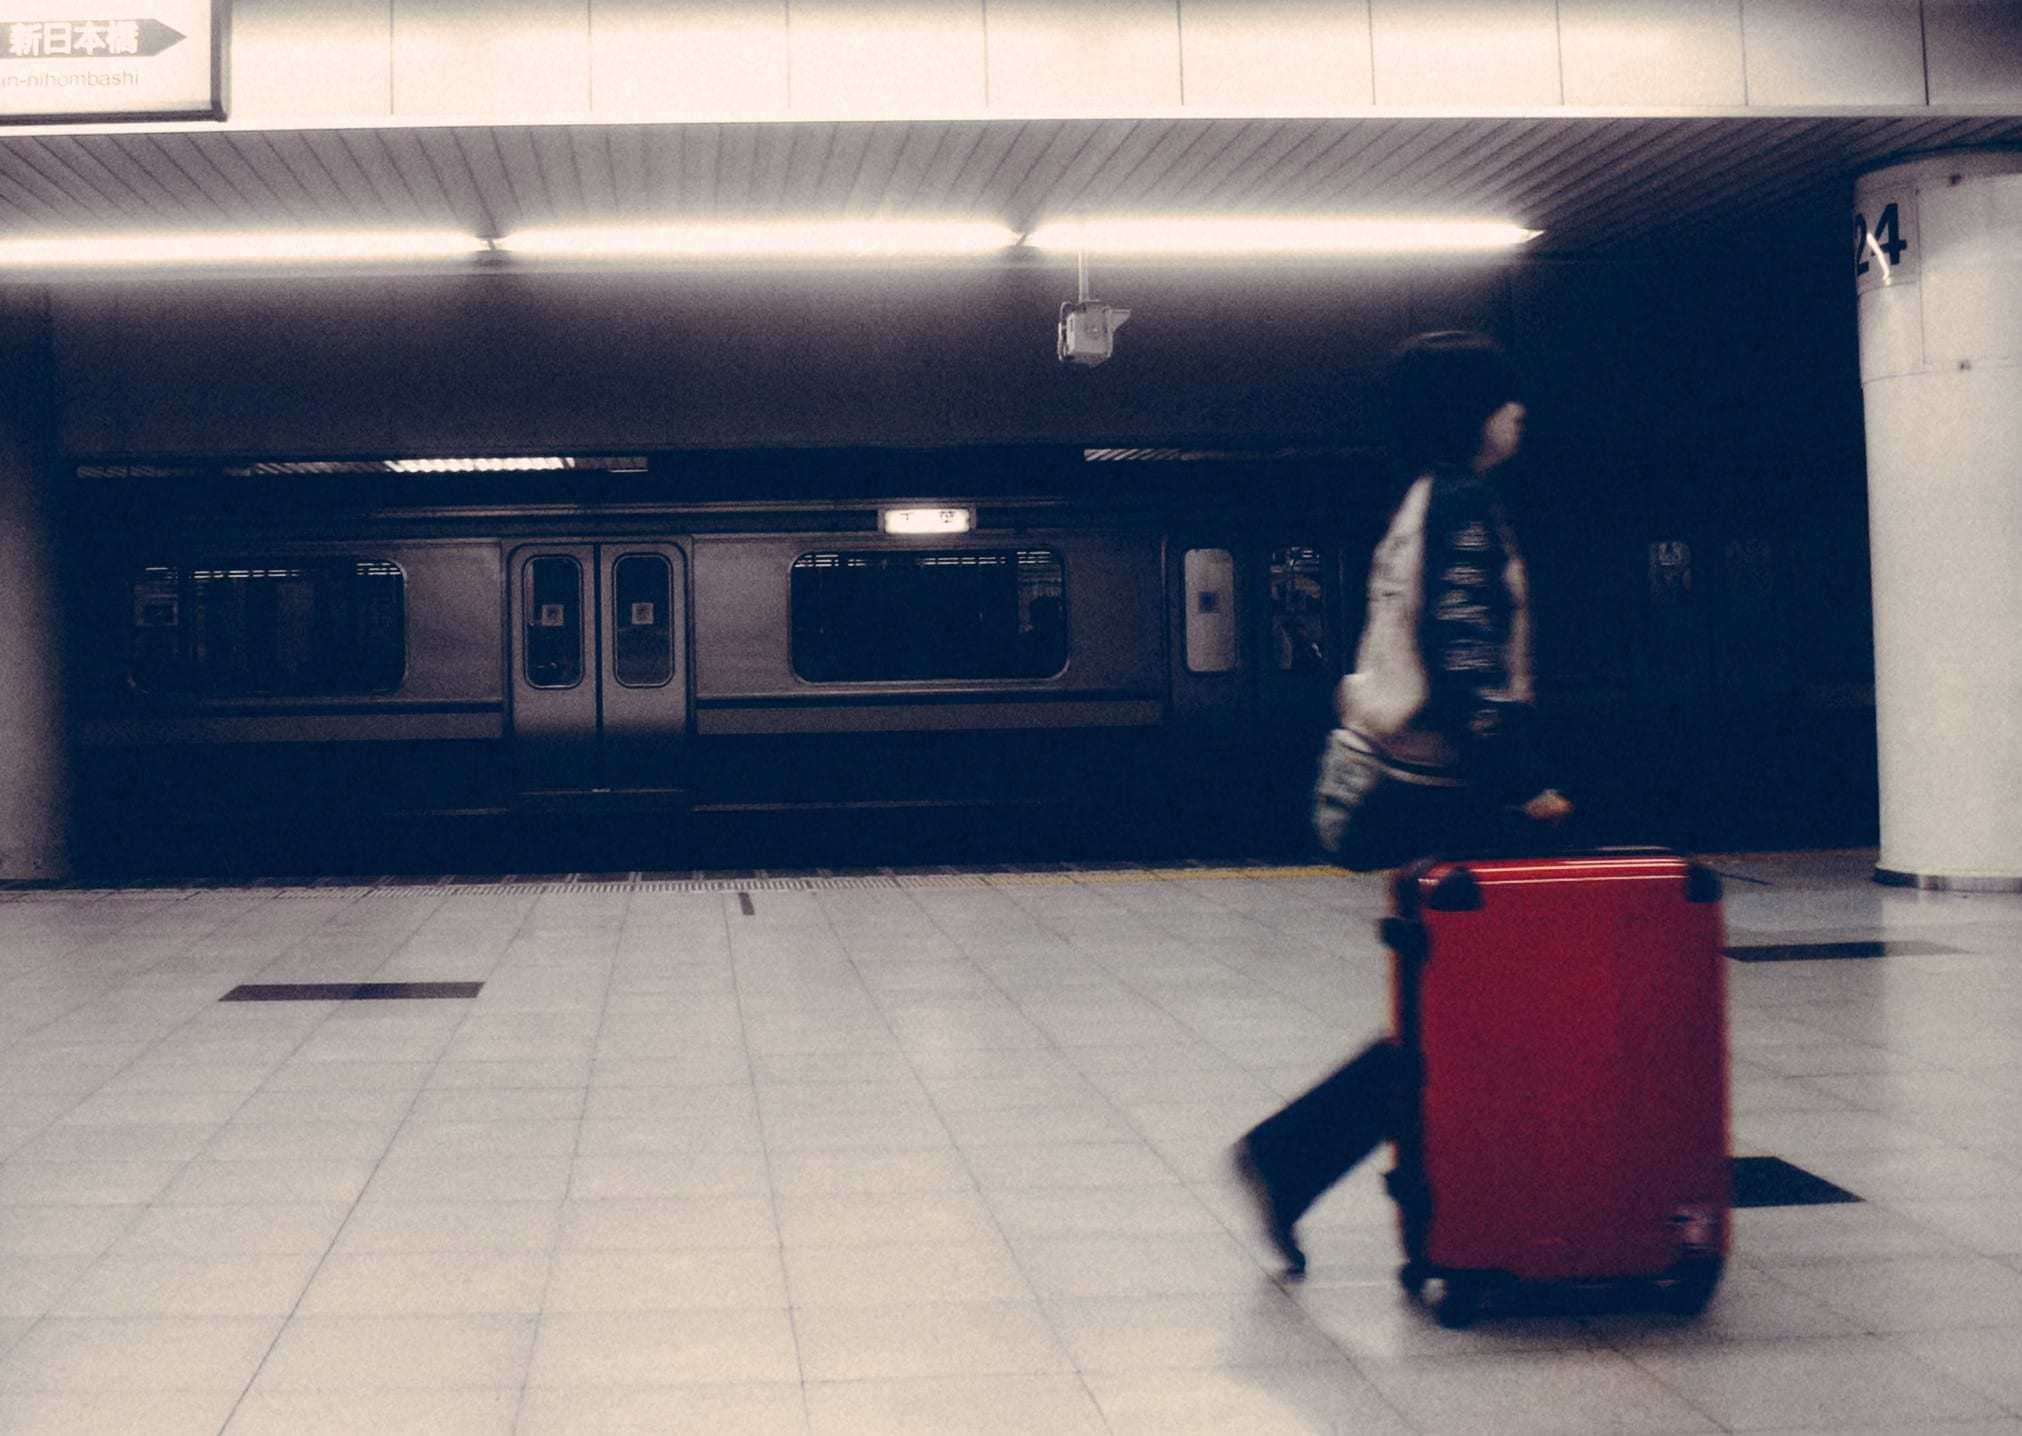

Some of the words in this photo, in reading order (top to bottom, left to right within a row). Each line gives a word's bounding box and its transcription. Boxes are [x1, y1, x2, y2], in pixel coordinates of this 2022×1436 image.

[9, 21, 139, 56] 新日本橋
[1855, 203, 1907, 276] 24
